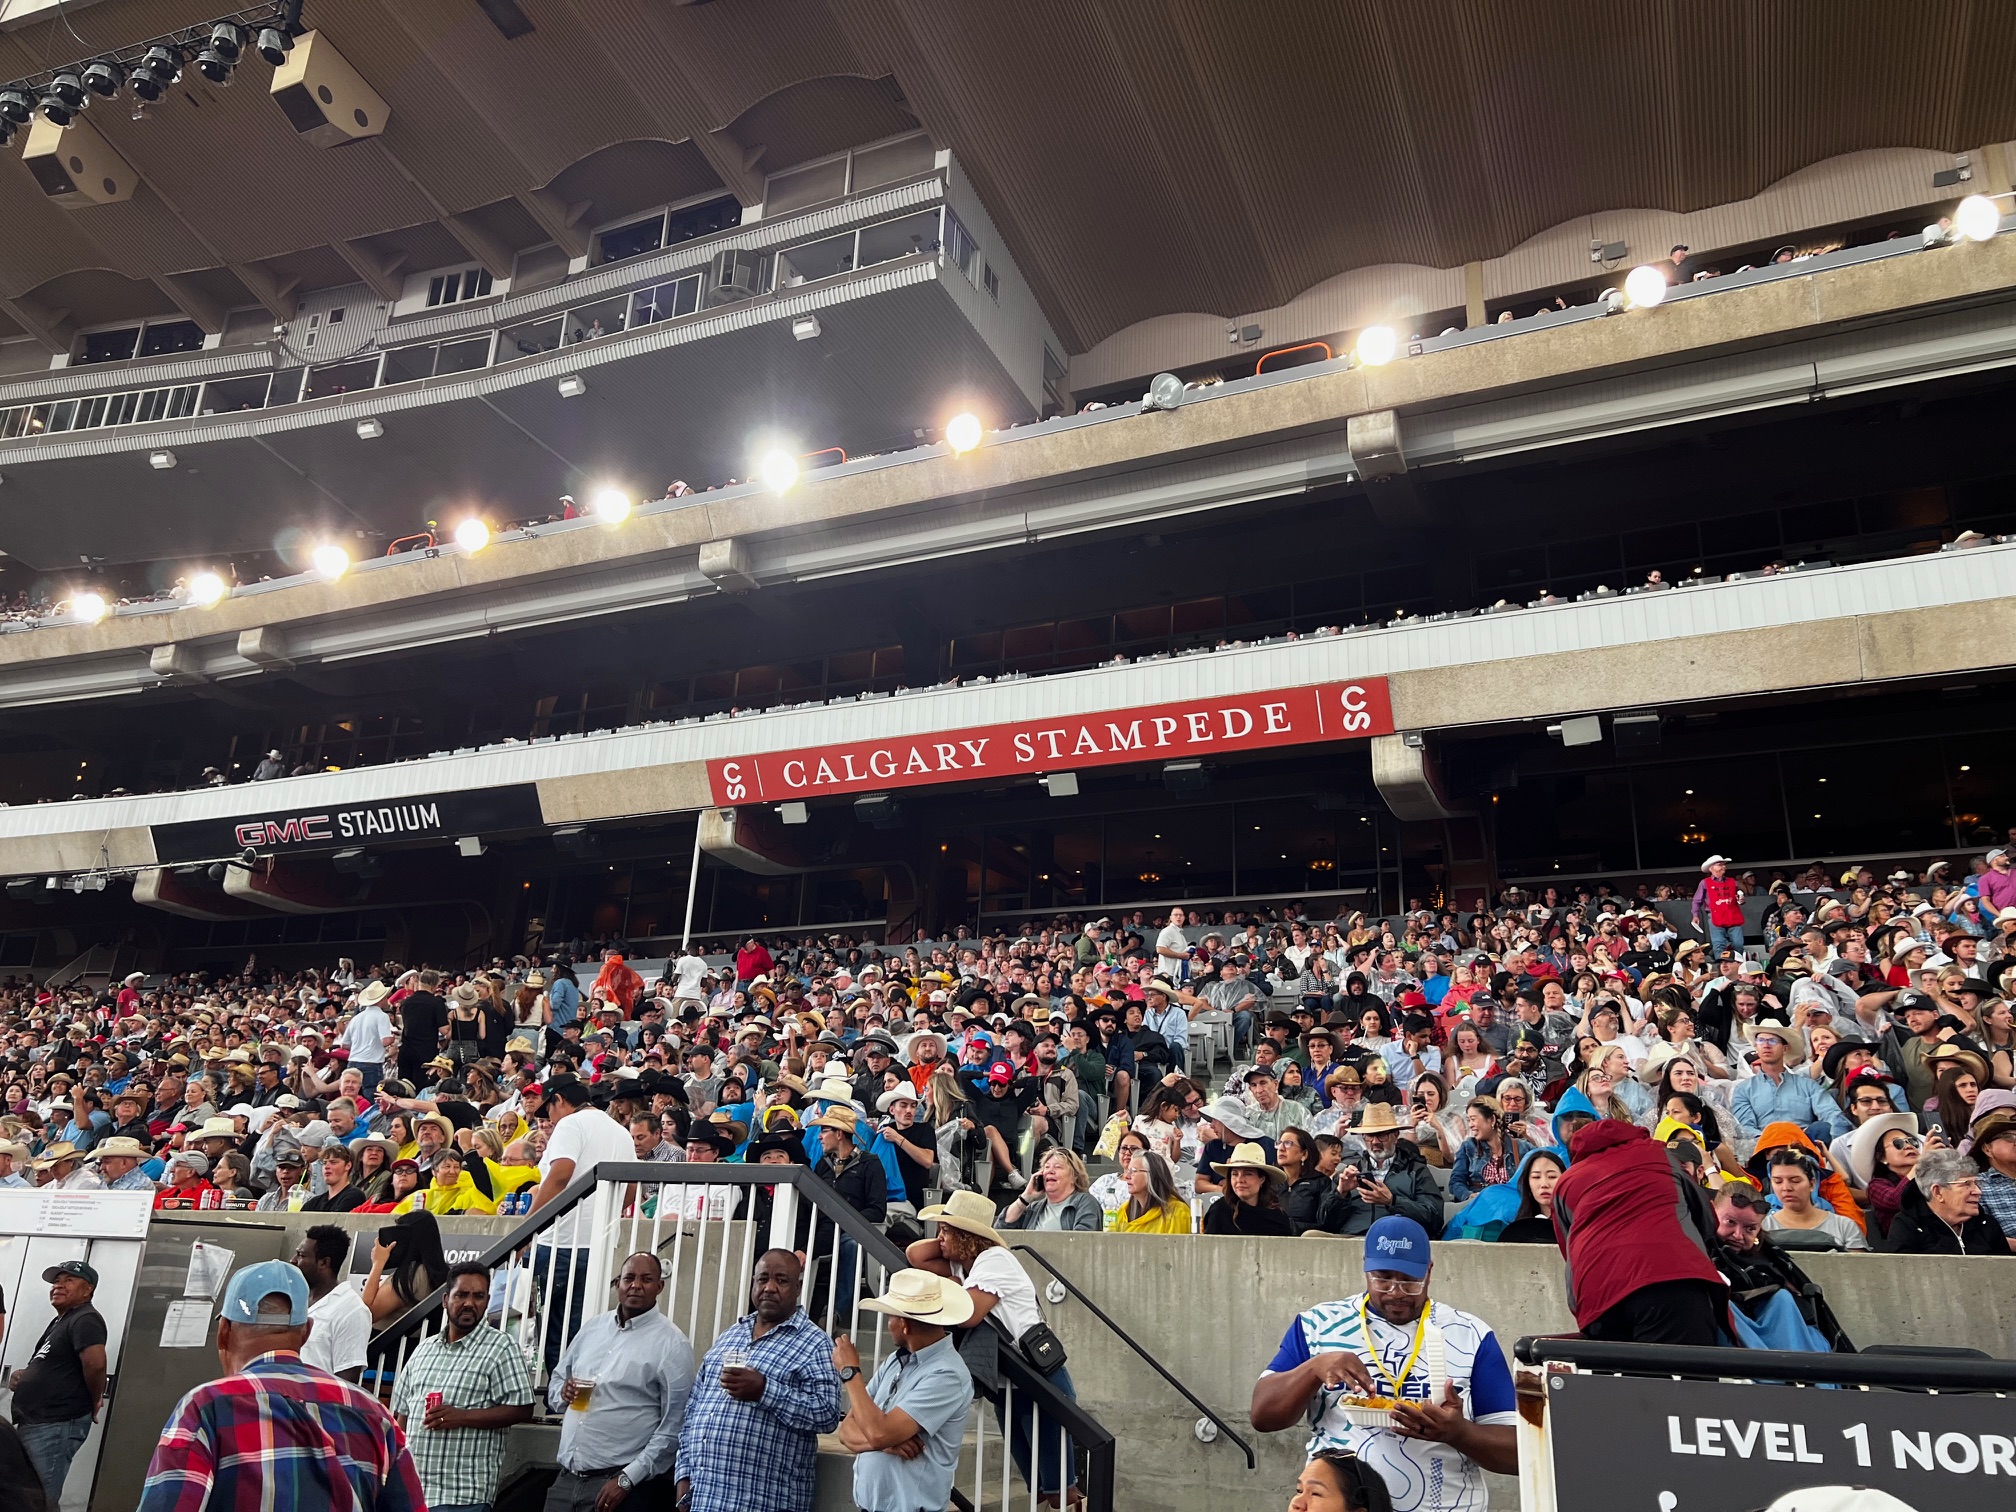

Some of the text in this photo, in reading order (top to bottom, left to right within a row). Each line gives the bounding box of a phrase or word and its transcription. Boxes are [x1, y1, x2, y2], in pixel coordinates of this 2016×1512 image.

[783, 702, 1292, 788] CALGARY STAMPEDE
[235, 803, 441, 847] GMC STADIUM
[1376, 1235, 1413, 1255] Royals
[1667, 1415, 2016, 1476] LEVEL 1 NOR
